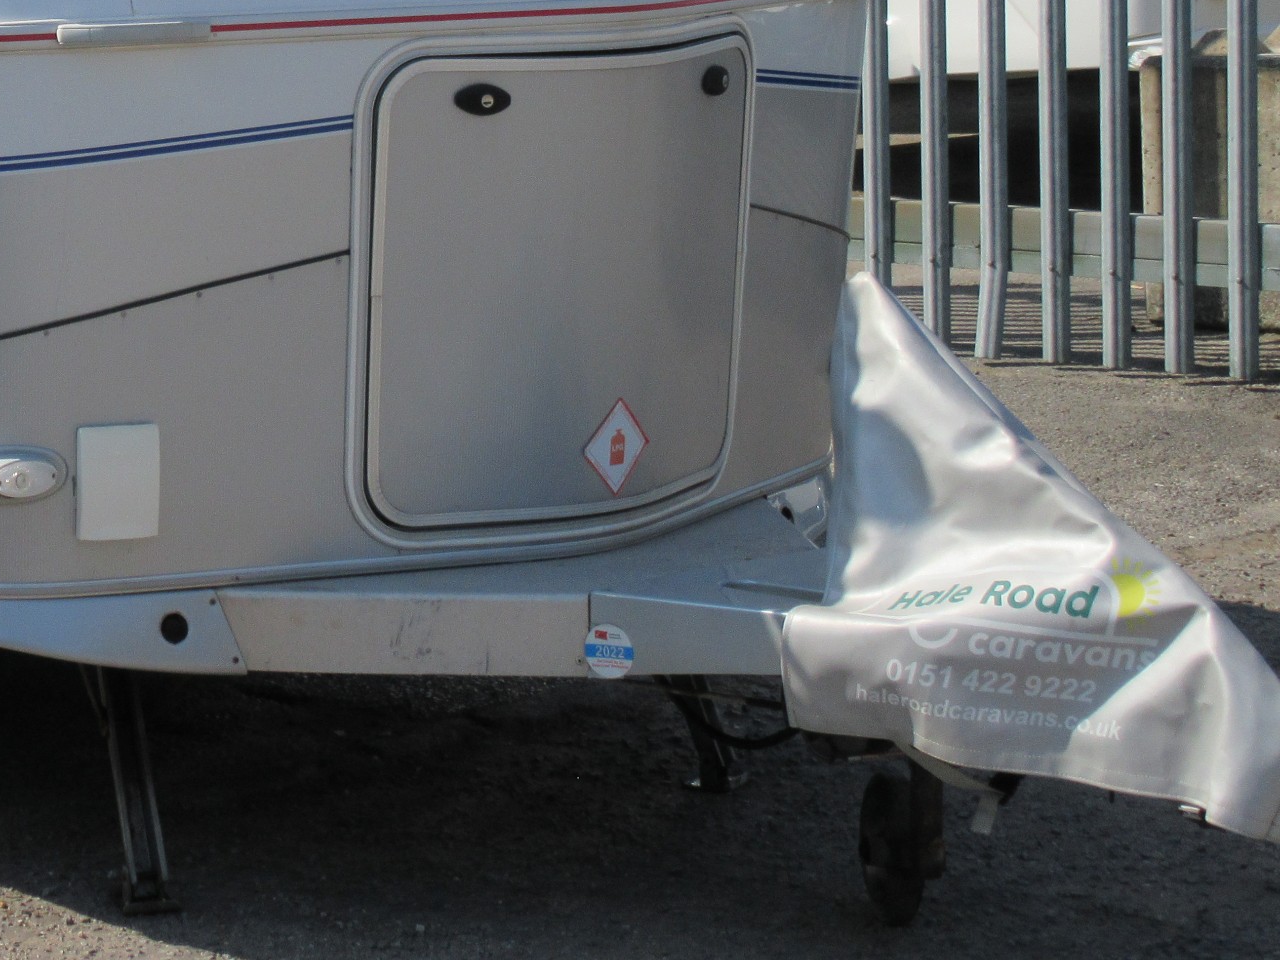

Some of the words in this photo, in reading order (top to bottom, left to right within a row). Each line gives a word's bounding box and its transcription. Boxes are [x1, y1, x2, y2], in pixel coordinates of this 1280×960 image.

[887, 583, 973, 611] Hale
[980, 579, 1100, 619] Road
[595, 644, 625, 659] 2022
[968, 631, 1158, 672] caravans
[886, 658, 952, 689] 0151
[962, 669, 1017, 695] 422
[1025, 675, 1097, 703] 9222
[854, 683, 1121, 741] haleroadcaravans.co.uk
